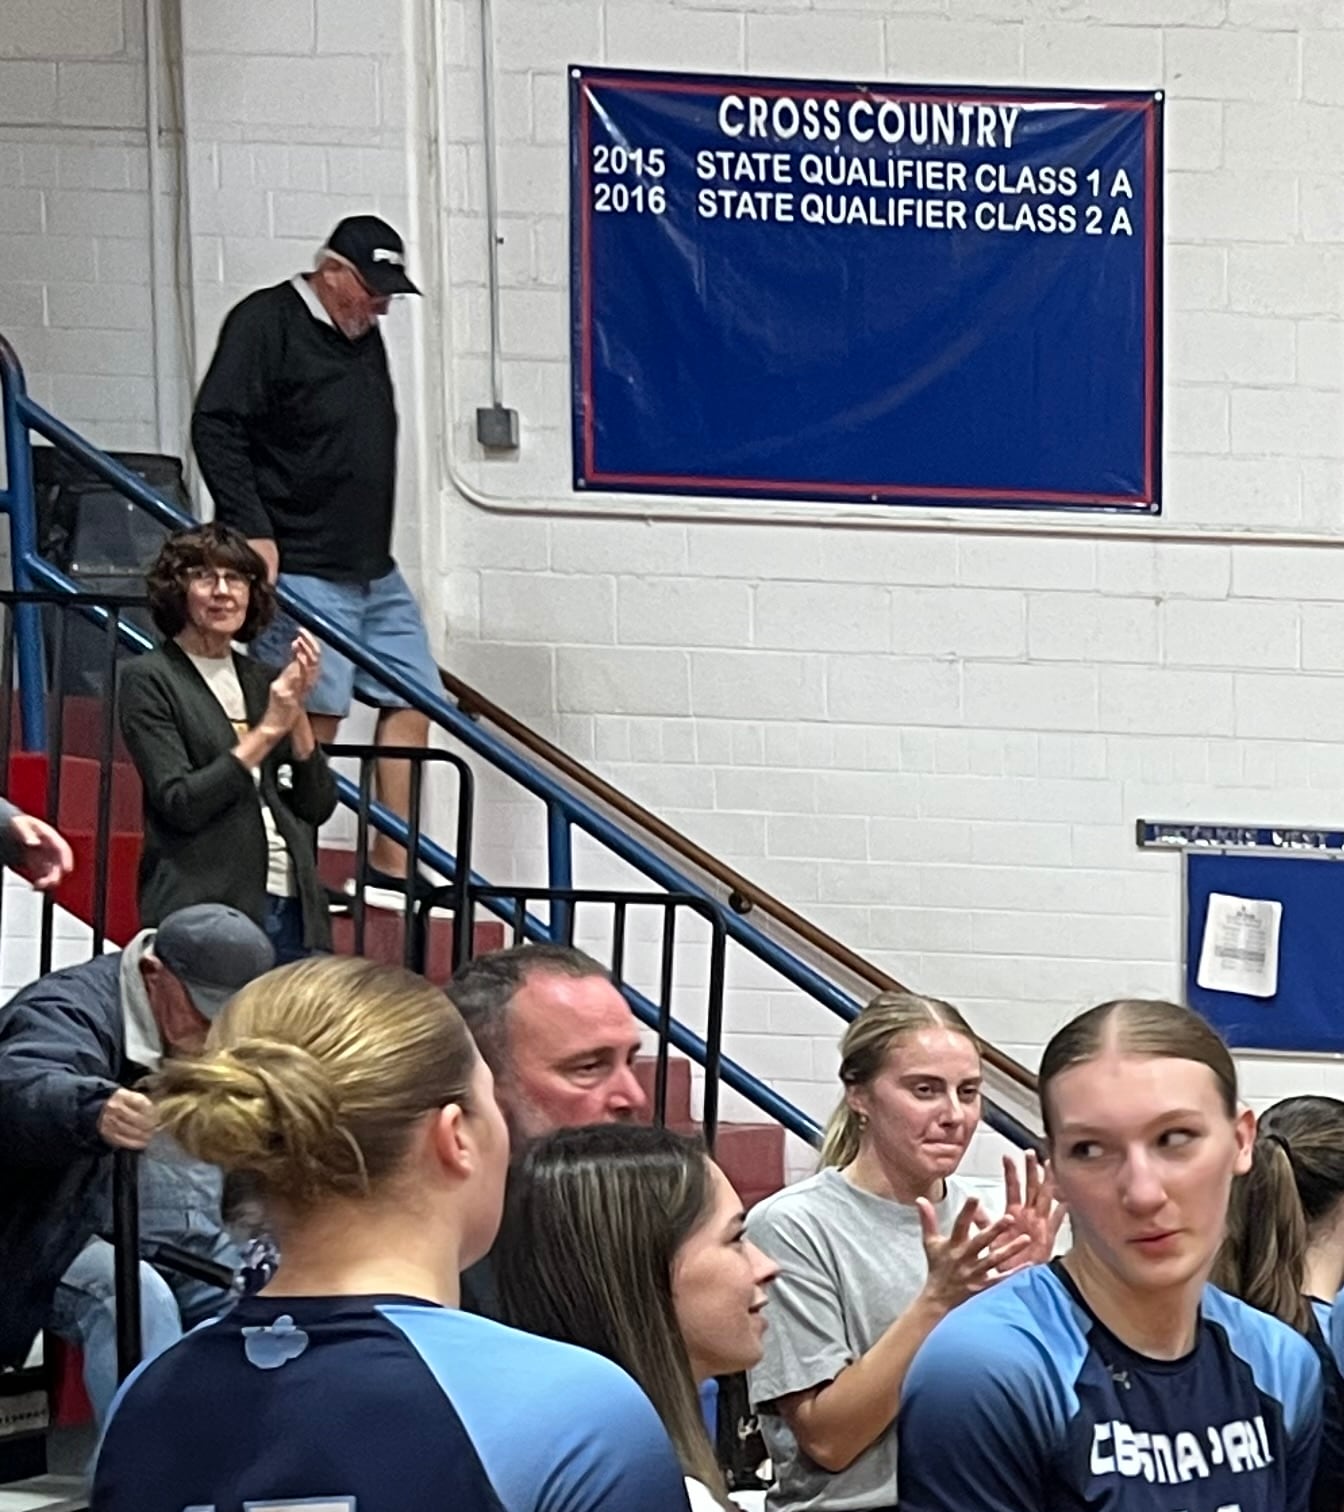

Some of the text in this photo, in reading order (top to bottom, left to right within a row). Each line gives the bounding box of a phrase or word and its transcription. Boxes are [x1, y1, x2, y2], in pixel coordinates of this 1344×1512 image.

[719, 94, 1019, 148] CROSS COUNTRY
[593, 144, 1133, 199] 2015 STATE QUALIFIER CLASS 1 A
[594, 183, 1133, 236] 2016 STATE QUALIFIER CLASS 2 A
